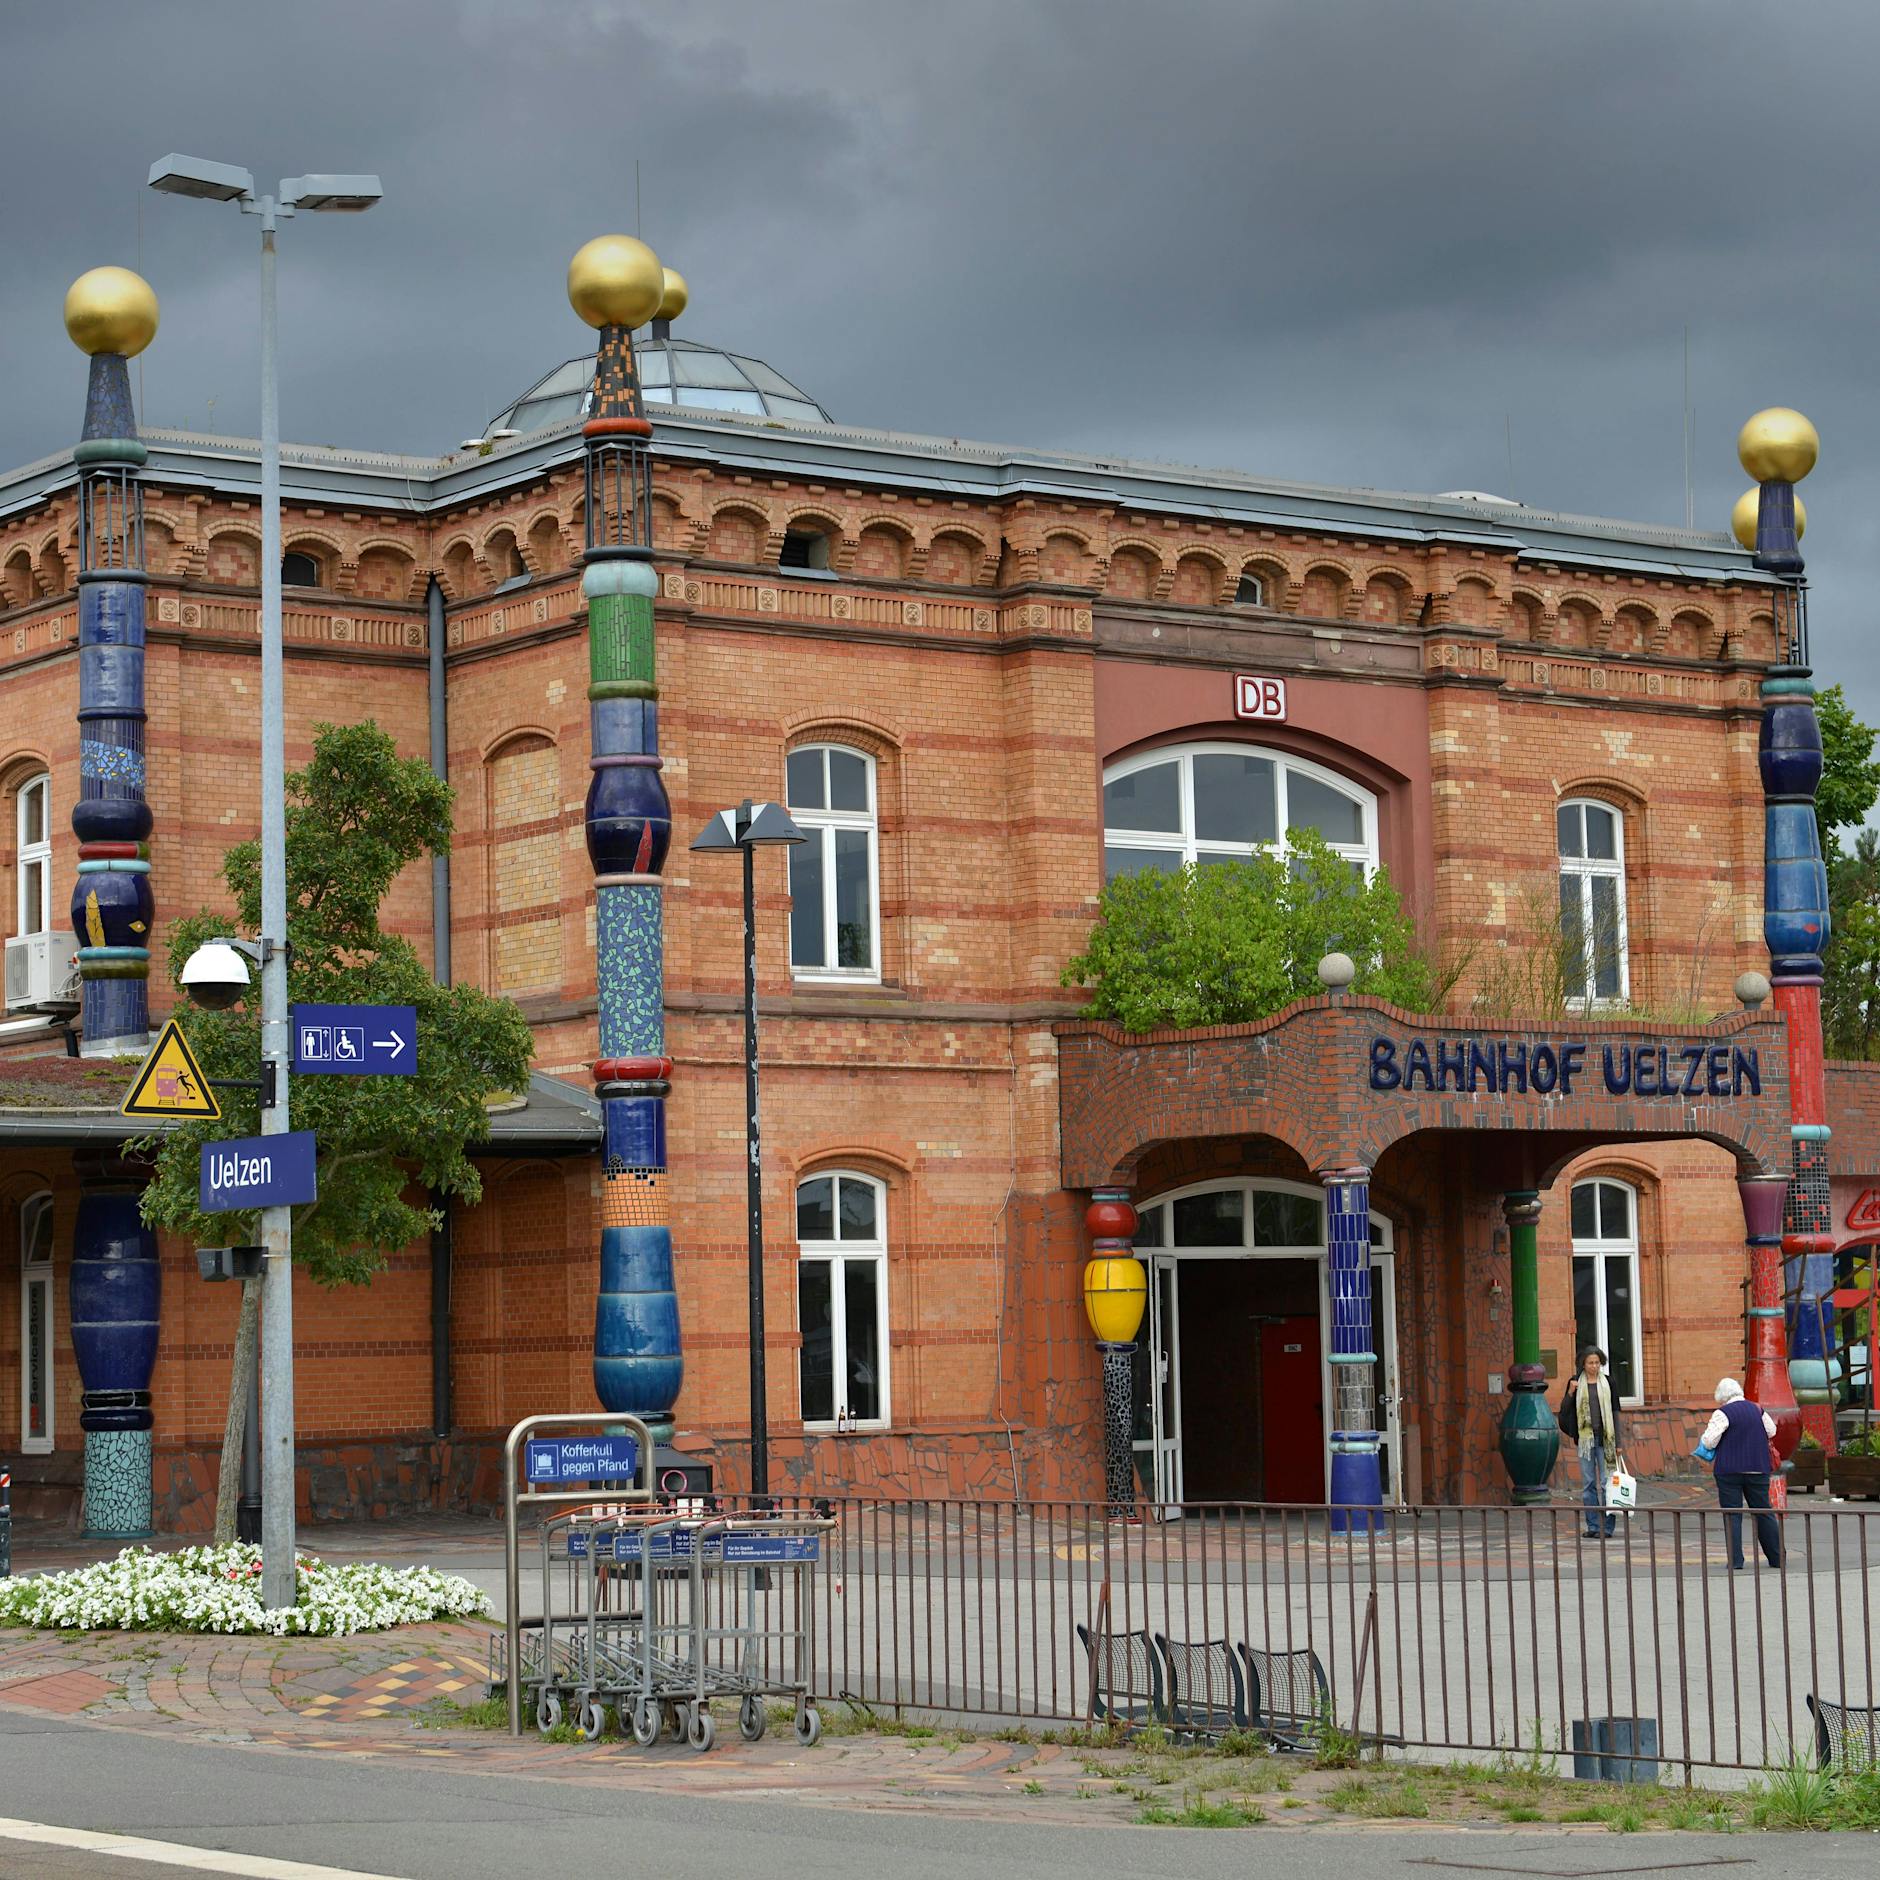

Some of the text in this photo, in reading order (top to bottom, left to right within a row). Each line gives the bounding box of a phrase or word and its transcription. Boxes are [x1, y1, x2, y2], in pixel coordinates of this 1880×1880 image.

[1241, 679, 1281, 715] DB
[1369, 1037, 1761, 1097] BAHNHOF UELZEN
[210, 1151, 272, 1190] Uelzen
[561, 1443, 613, 1457] Kofferkuli
[562, 1458, 629, 1476] gegen Pfand
